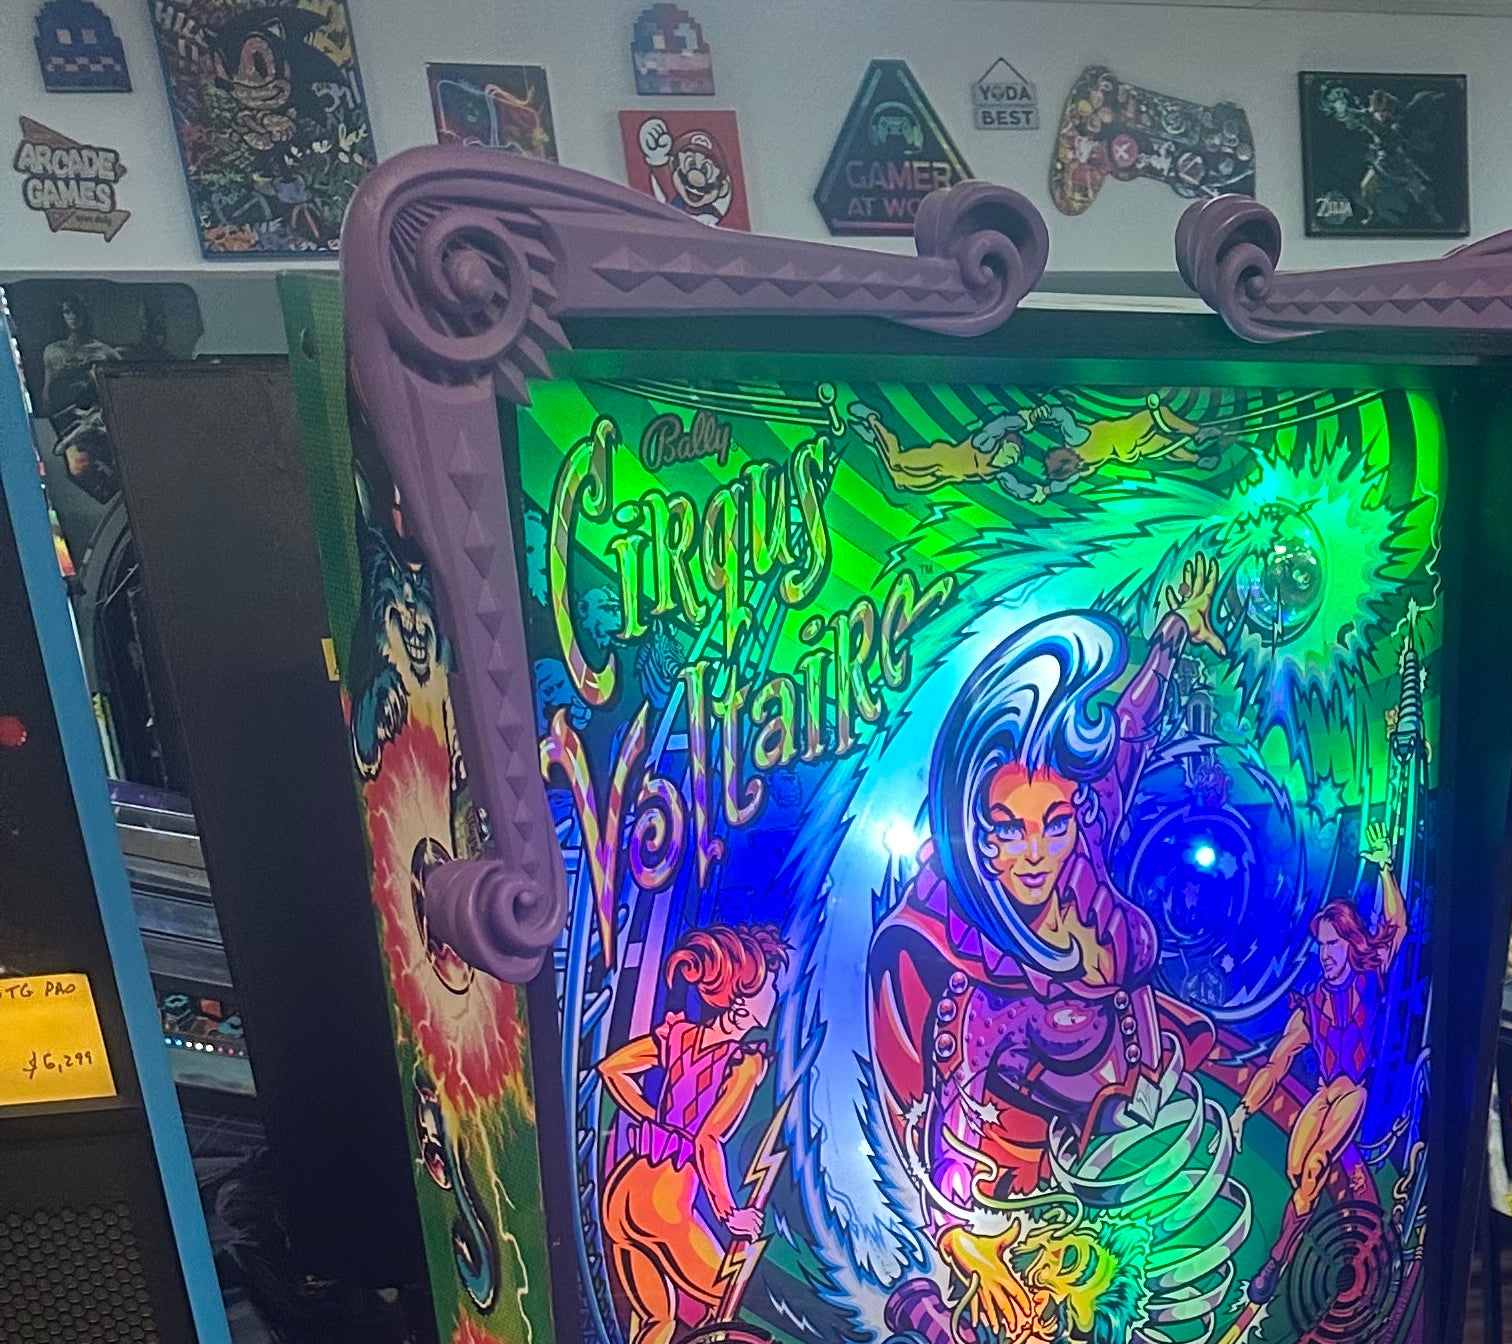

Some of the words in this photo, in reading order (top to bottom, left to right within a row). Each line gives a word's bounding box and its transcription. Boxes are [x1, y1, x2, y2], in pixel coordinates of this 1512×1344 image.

[981, 110, 1034, 126] BEST
[18, 143, 116, 180] ARCADE
[845, 160, 951, 190] GAMER
[26, 178, 113, 212] GAMES
[848, 197, 873, 216] AT
[641, 412, 731, 472] Bally
[23, 1051, 93, 1080] $6,299
